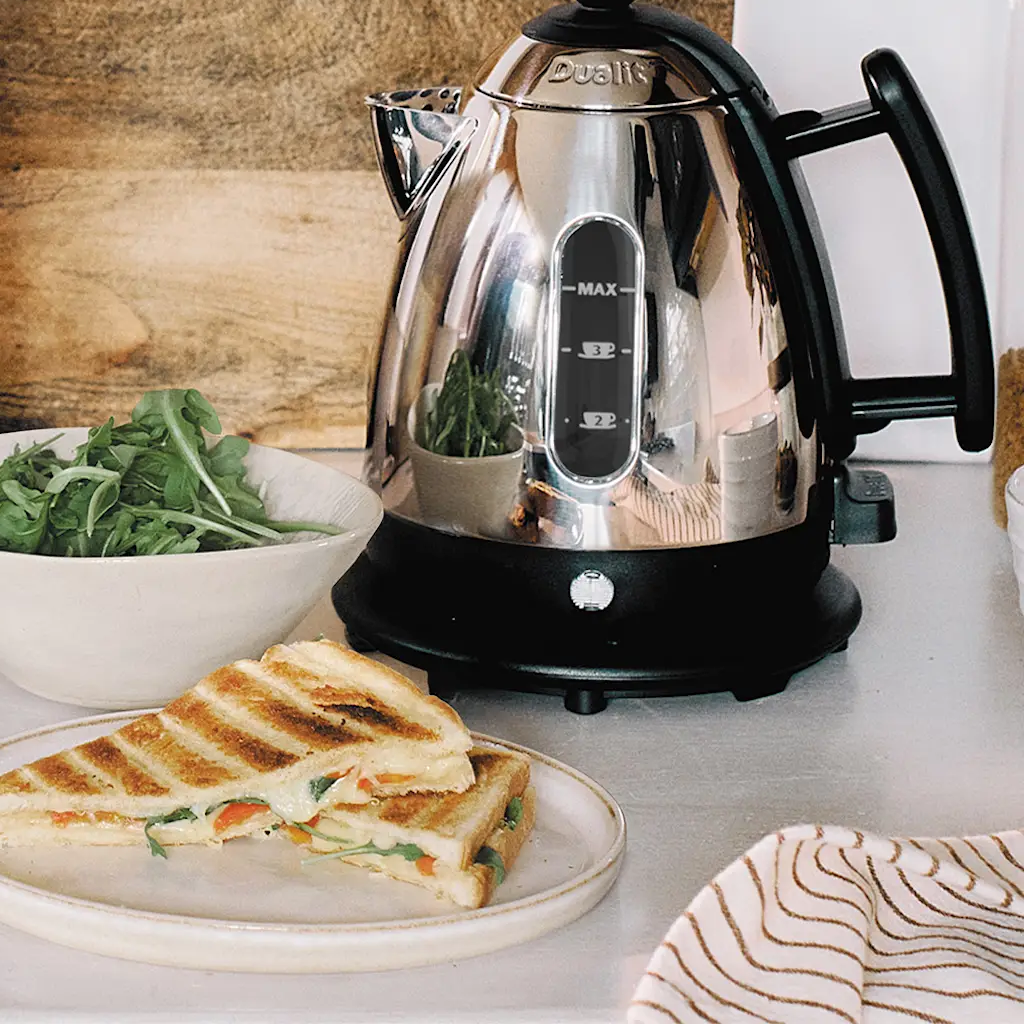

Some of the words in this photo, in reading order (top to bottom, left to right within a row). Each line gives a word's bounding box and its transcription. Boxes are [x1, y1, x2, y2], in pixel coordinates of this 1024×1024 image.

[548, 58, 649, 85] Dualit
[578, 282, 617, 296] MAX
[592, 344, 601, 356] 3
[594, 415, 603, 426] 2
